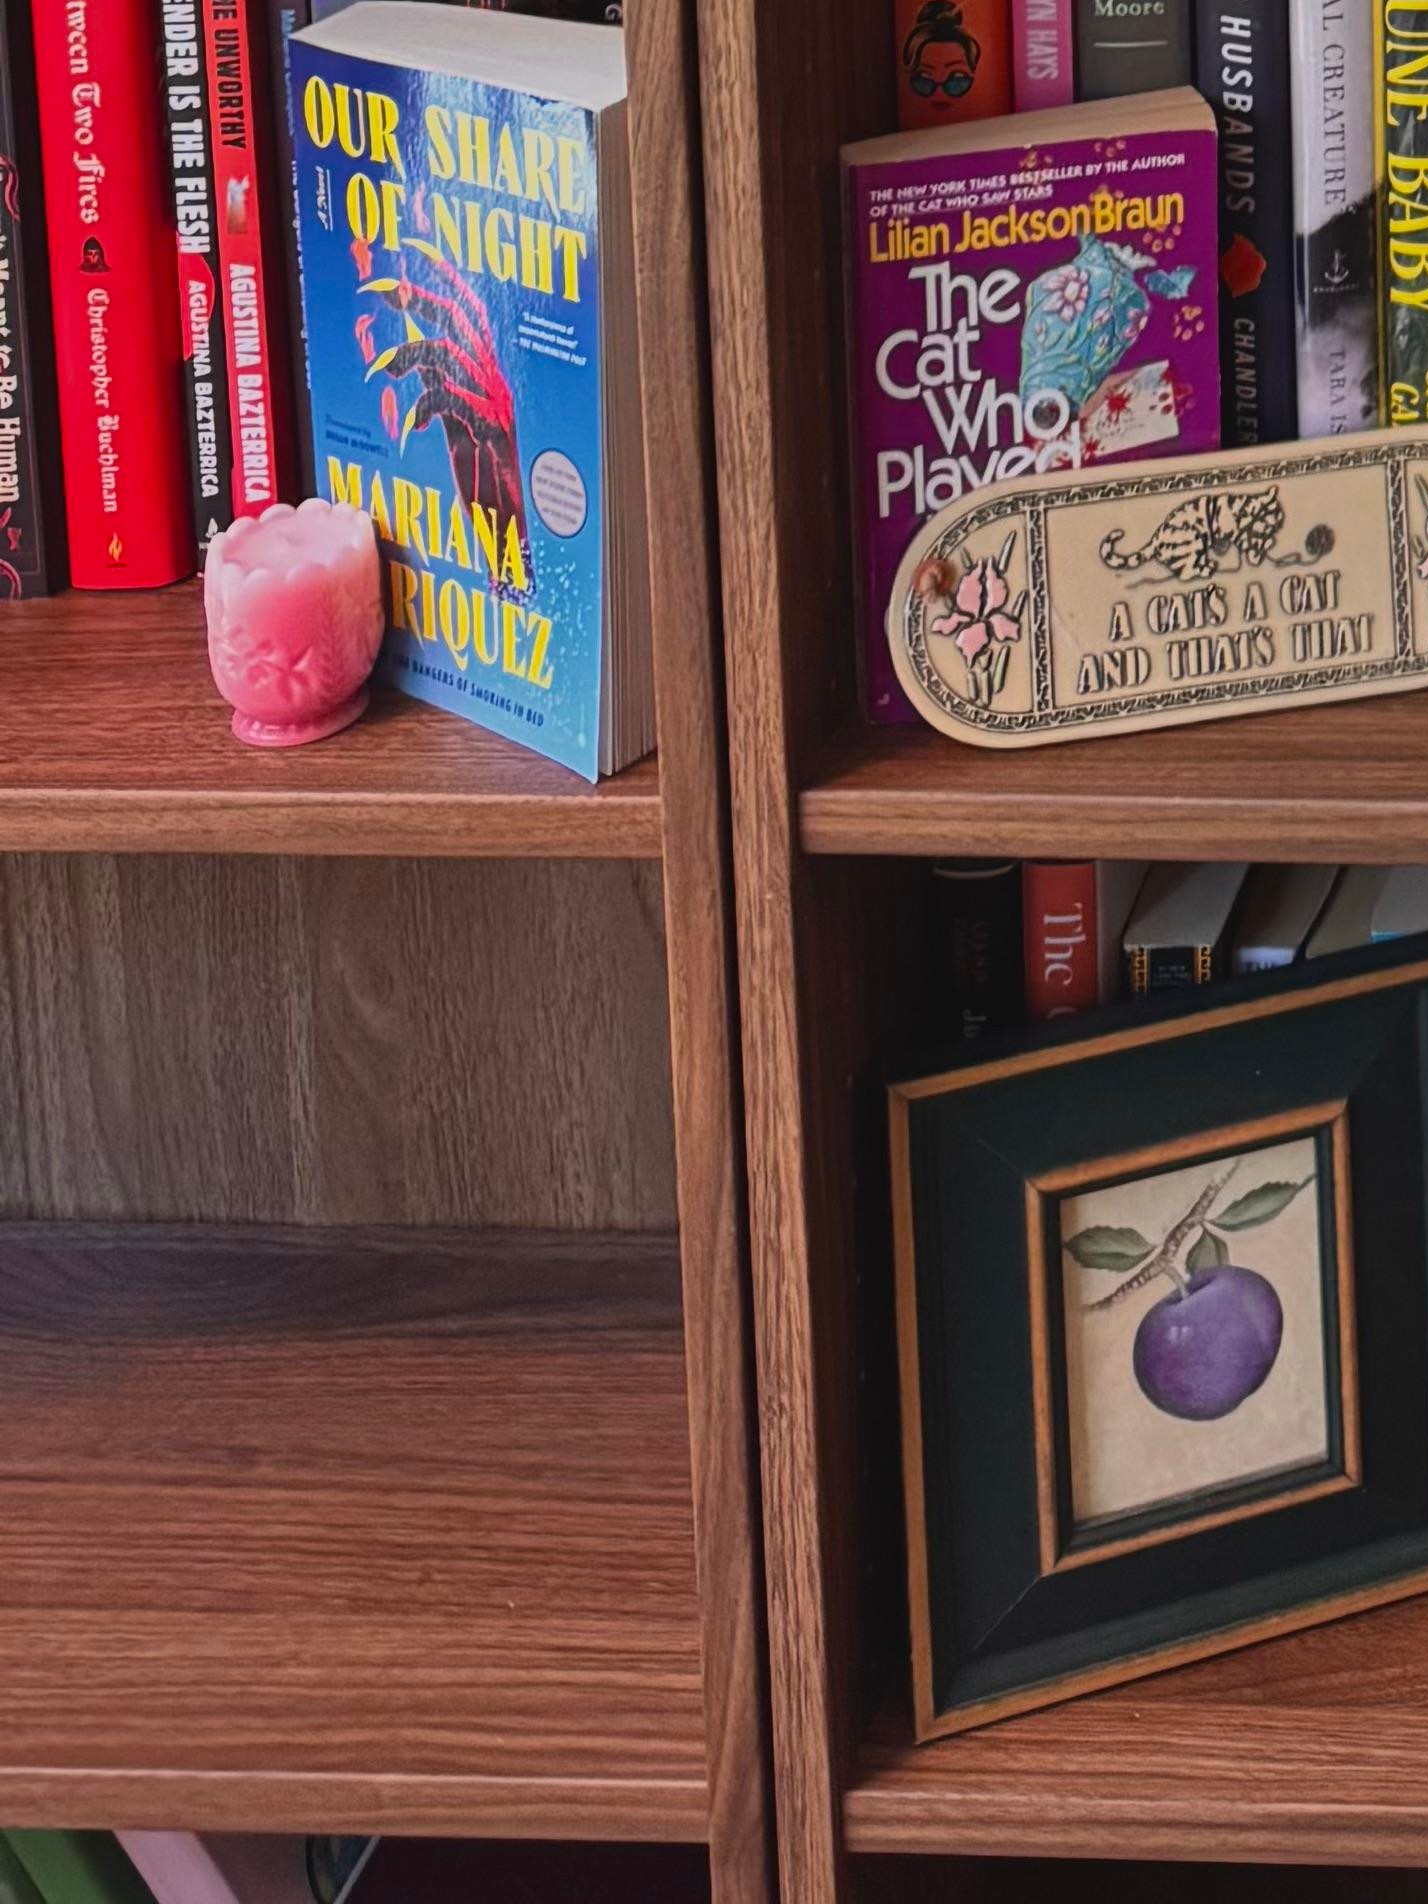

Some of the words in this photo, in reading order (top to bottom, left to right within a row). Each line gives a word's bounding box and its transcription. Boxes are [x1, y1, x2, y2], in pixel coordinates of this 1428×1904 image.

[304, 75, 406, 182] OUR
[426, 106, 586, 220] SHARE
[346, 173, 405, 252] OF
[433, 192, 587, 303] NIGHT
[869, 220, 949, 263] Lilian
[954, 203, 1090, 253] Jackson
[1093, 192, 1184, 233] Braun
[908, 261, 1021, 332] The
[876, 317, 982, 400] Cat
[922, 378, 1070, 456] Who
[1109, 601, 1134, 641] A
[1244, 580, 1267, 621] A
[1279, 569, 1341, 616] CAT
[1077, 647, 1152, 695] AND
[1290, 613, 1375, 662] THAT
